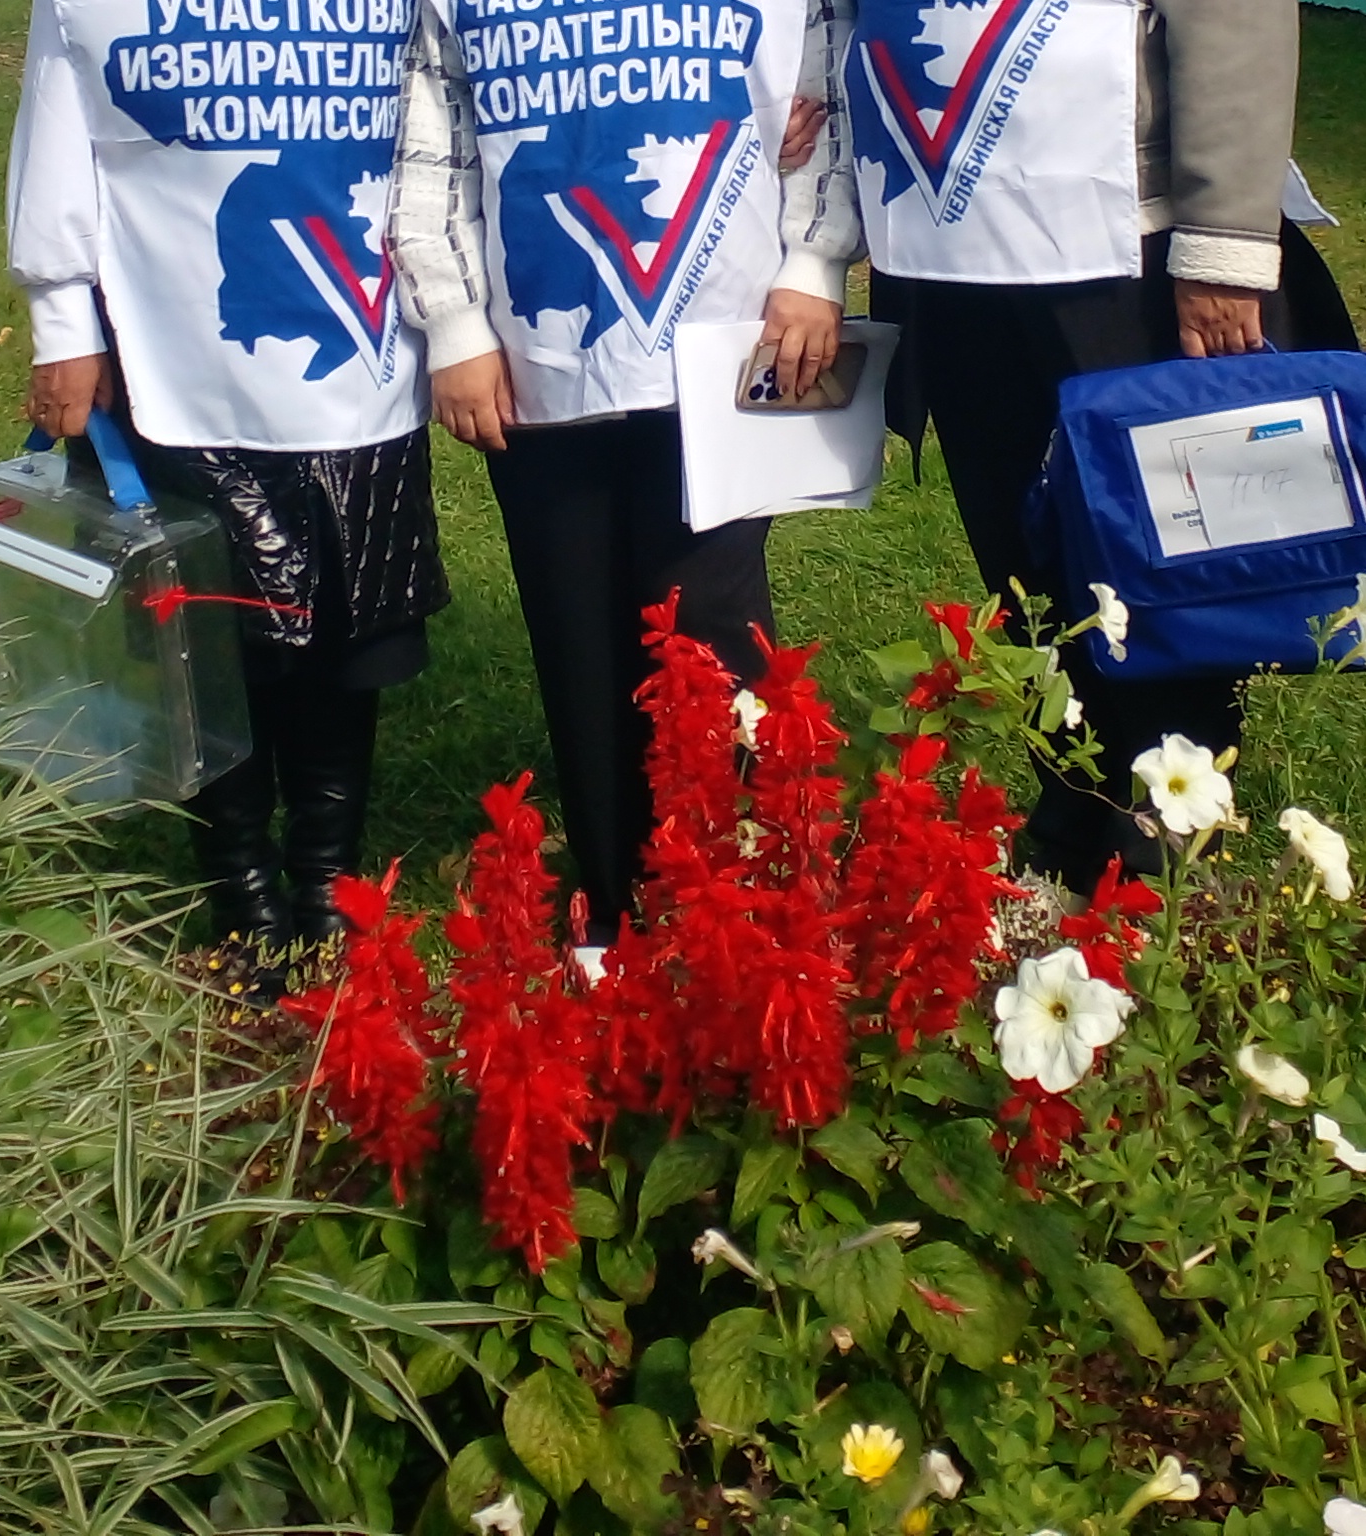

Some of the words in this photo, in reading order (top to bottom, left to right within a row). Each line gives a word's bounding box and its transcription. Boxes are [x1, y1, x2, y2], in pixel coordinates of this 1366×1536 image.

[119, 41, 405, 92] ИЗБИРАТЕЛЬН
[456, 4, 753, 73] БИРАТЕЛЬНАЯ
[470, 58, 712, 126] КОМИССИЯ
[943, 84, 1020, 225] ЧЕЛЯБИНСКАЯ
[657, 218, 727, 353] ЧЕЛЯБИНСКАЯ
[718, 138, 762, 219] ОБЛАСТЬ
